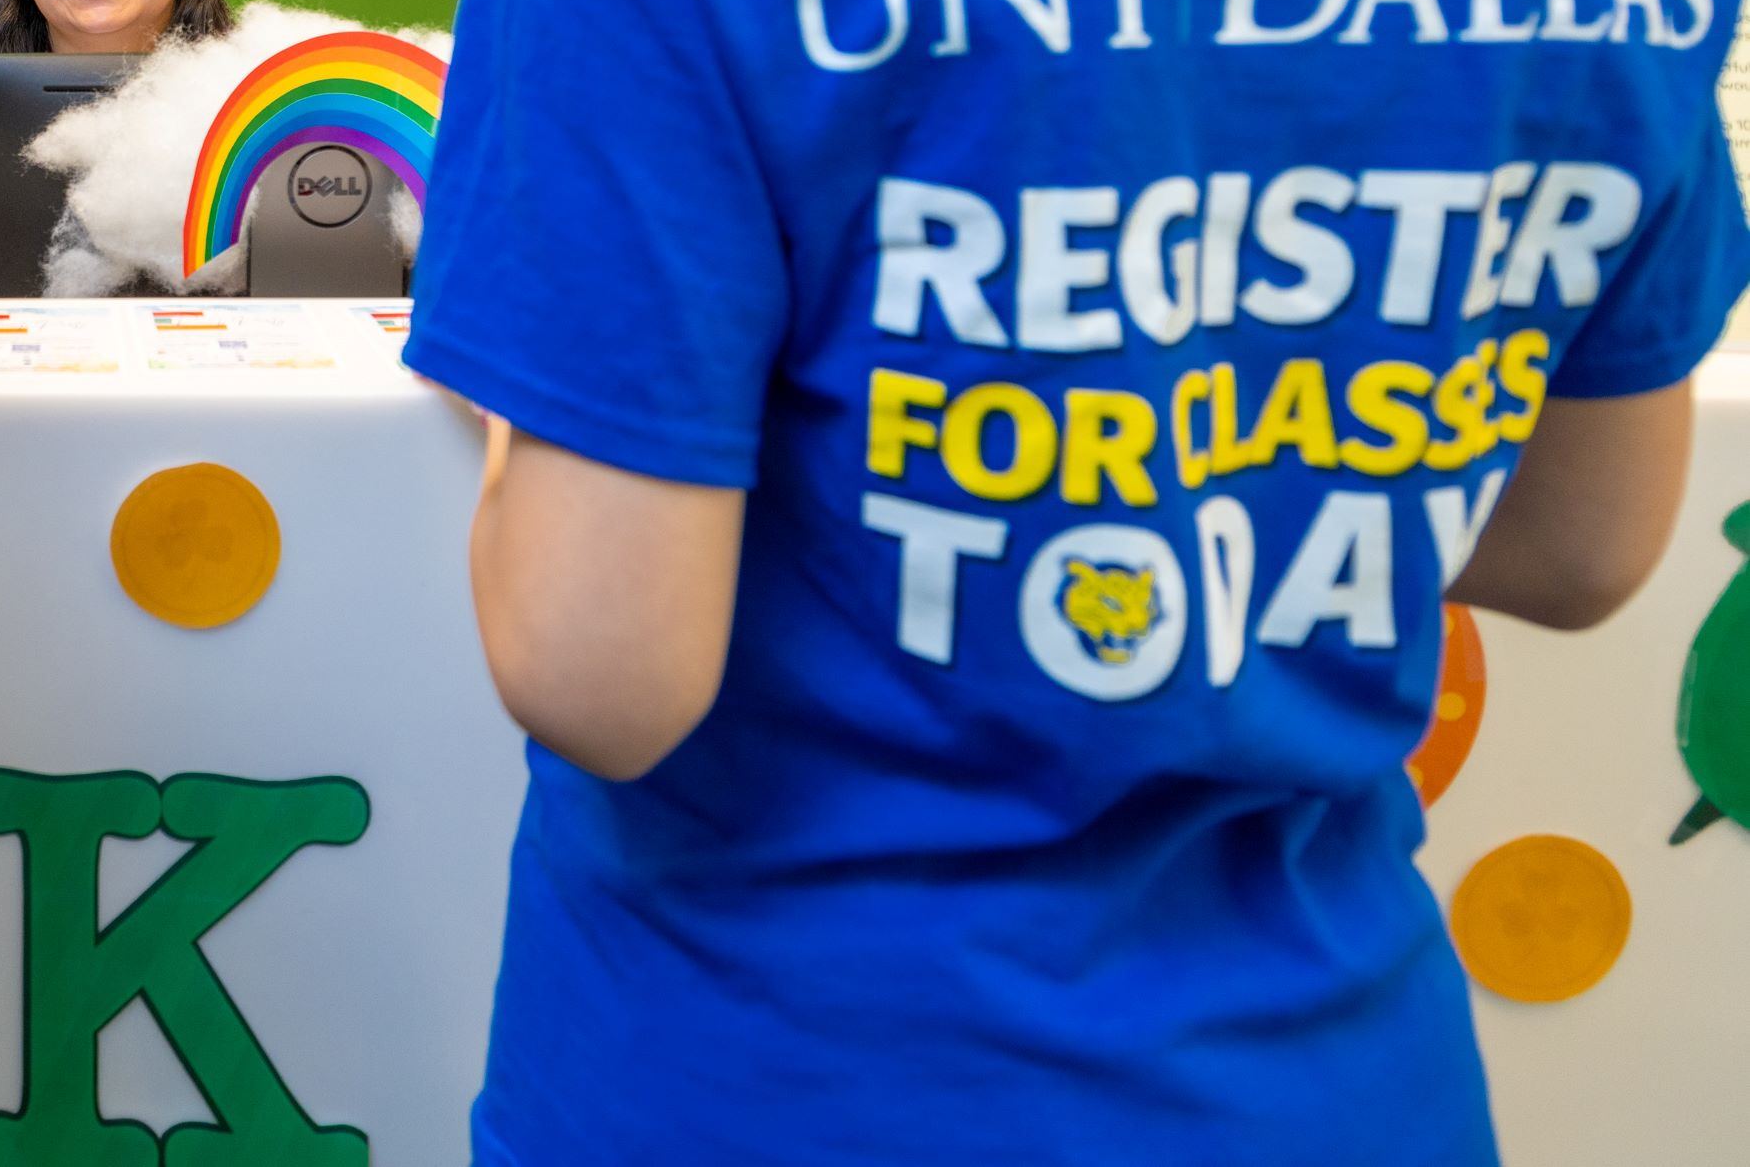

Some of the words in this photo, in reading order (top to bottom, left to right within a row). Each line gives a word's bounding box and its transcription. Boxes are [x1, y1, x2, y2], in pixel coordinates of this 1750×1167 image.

[297, 175, 362, 197] DELL
[872, 161, 1642, 352] REGISTER
[866, 369, 1158, 506] FOR
[1173, 328, 1550, 489] CLASSES
